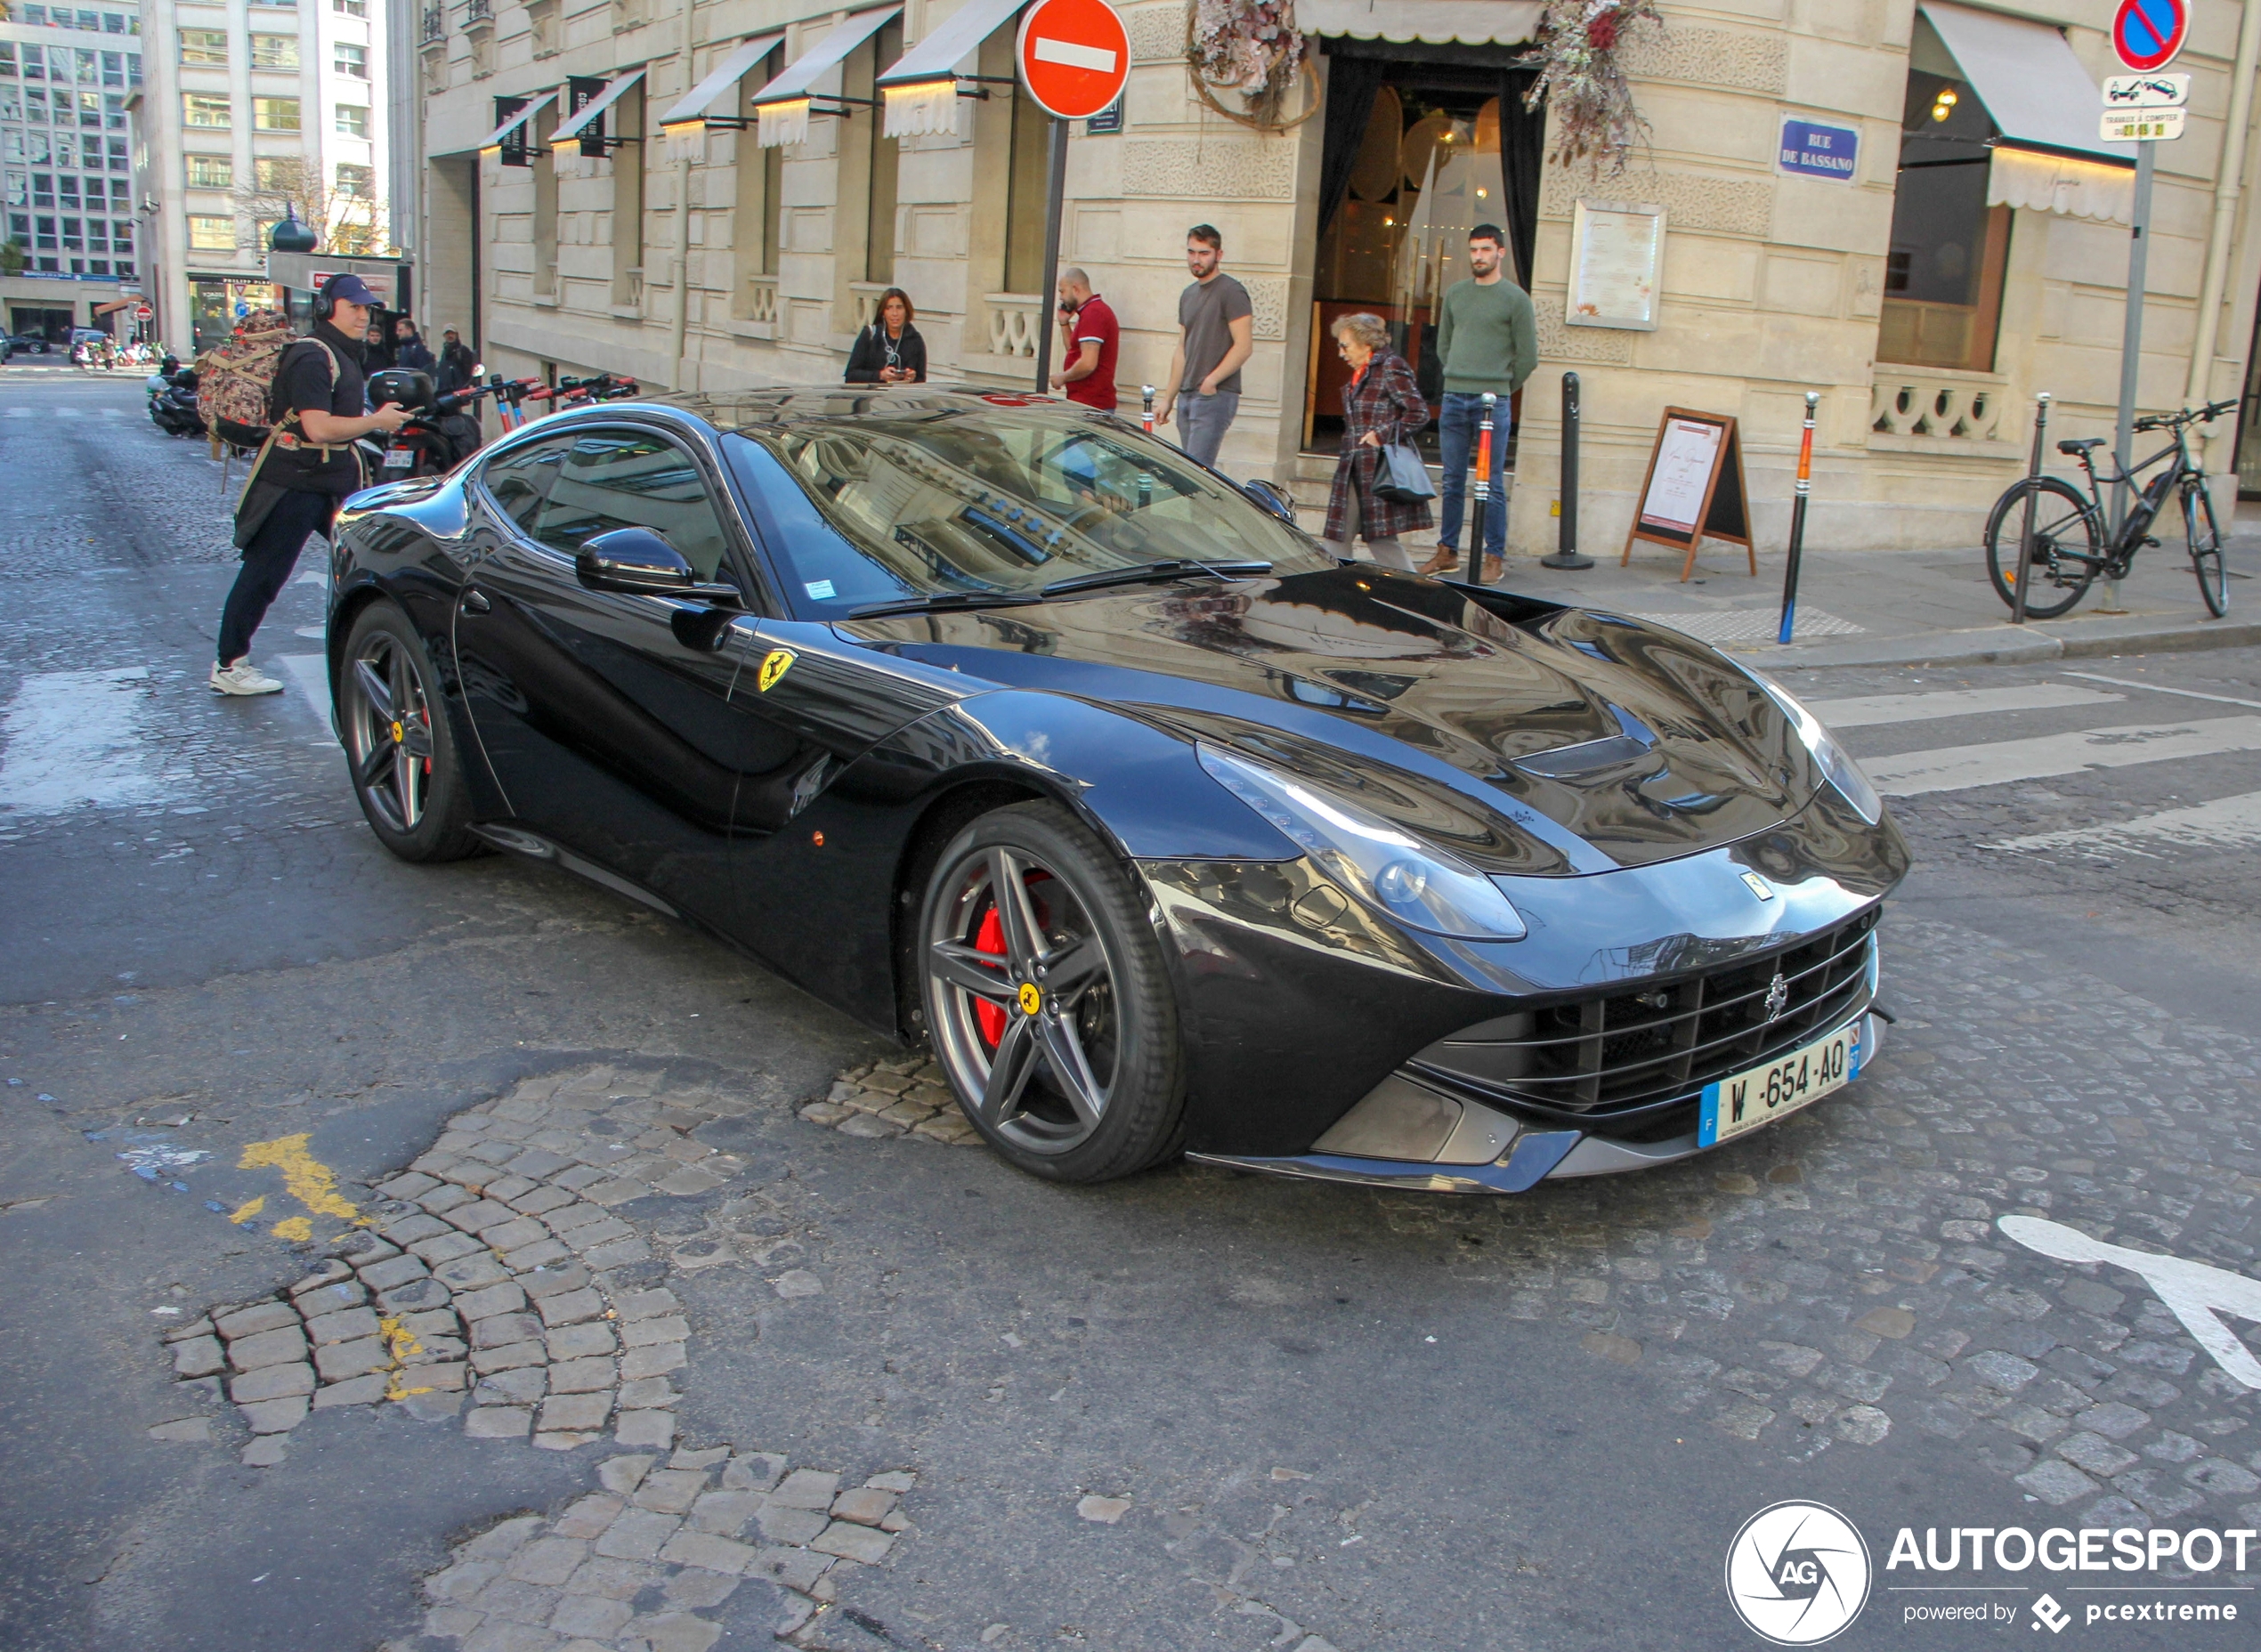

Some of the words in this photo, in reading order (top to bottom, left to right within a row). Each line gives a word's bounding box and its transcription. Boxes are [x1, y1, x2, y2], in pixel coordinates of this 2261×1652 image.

[2145, 114, 2178, 122] COMPTER
[1808, 134, 1832, 149] RUE
[1781, 149, 1798, 164] DE
[1800, 152, 1852, 171] BASSANO
[1706, 1119, 1713, 1130] F
